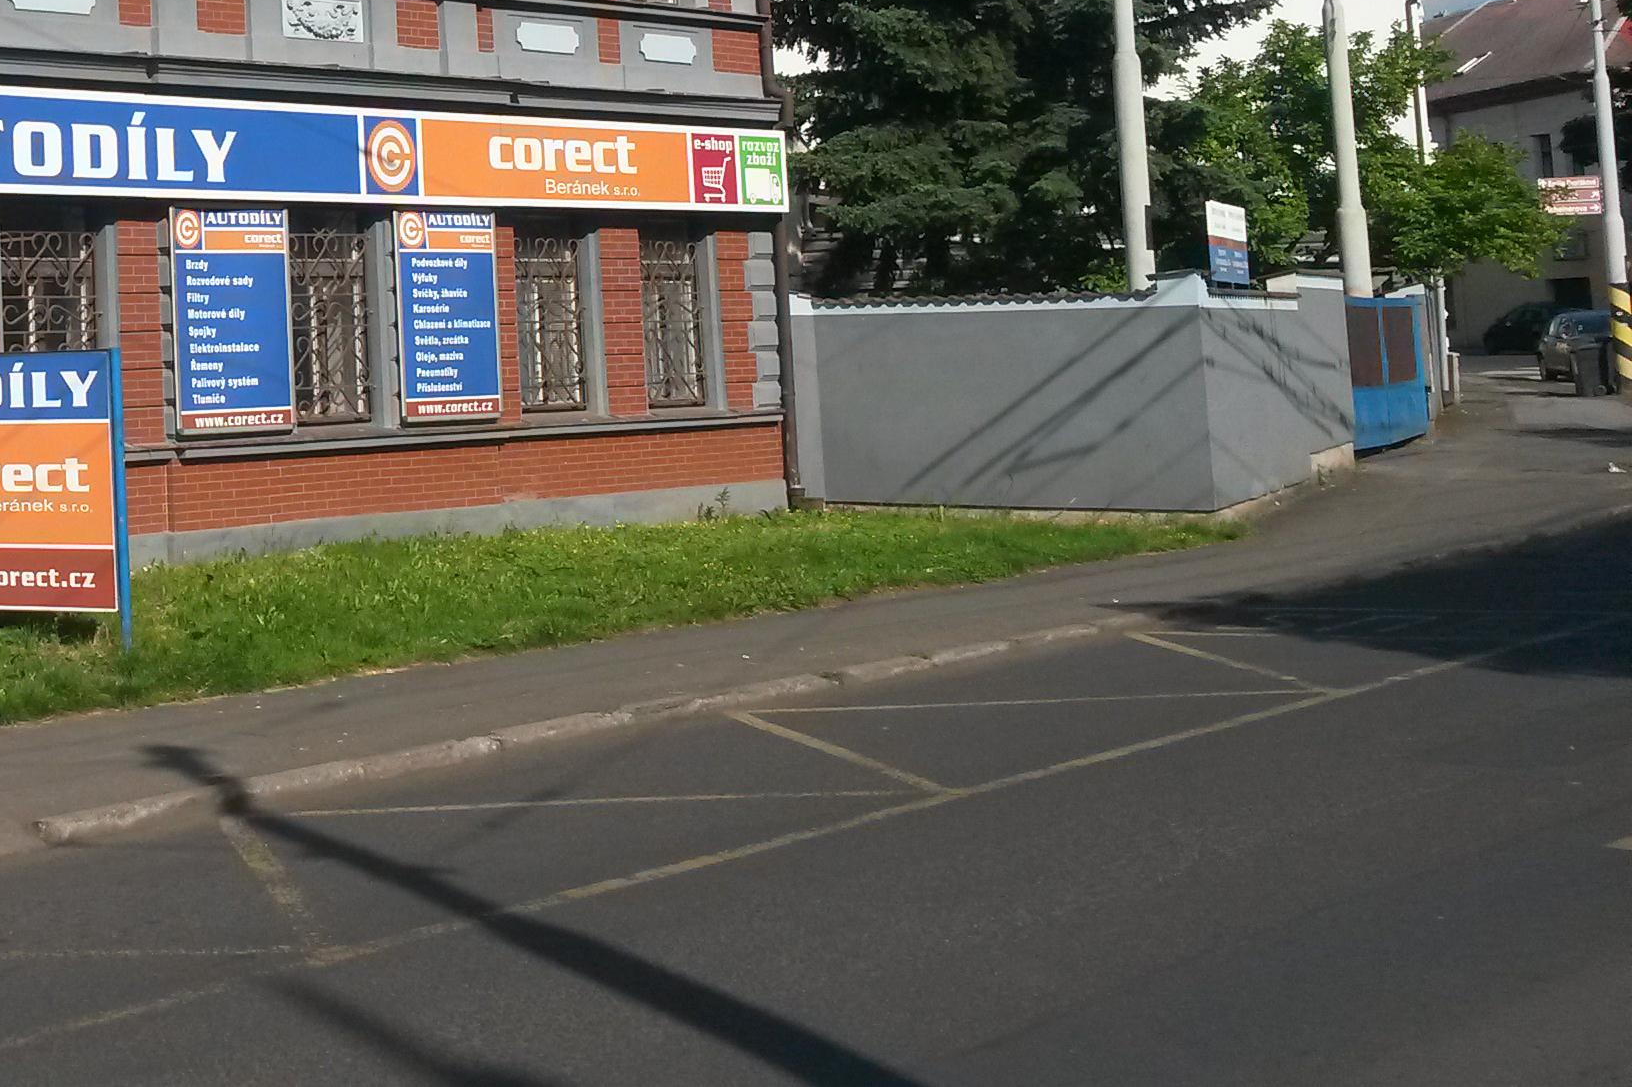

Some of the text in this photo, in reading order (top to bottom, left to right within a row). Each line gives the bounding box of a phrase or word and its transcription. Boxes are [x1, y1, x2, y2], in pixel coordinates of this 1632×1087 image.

[693, 137, 734, 155] e-shop
[741, 140, 780, 154] rozvoz
[488, 135, 638, 175] corect
[746, 152, 776, 167] zboží
[545, 178, 641, 197] Beránek s.r.o.
[206, 210, 282, 225] AUTODÍLY
[428, 213, 490, 226] AUTODÍLY
[244, 234, 282, 243] corect
[460, 234, 490, 244] corect
[185, 259, 208, 271] Brzdy
[411, 257, 467, 269] Podvozkové díly
[186, 275, 253, 287] Rozvodové sady
[412, 273, 437, 284] Výfuky
[187, 292, 209, 304] Filtry
[188, 308, 245, 320] Motorové díly
[413, 304, 449, 314] Karosérie
[454, 319, 491, 328] klimatizace
[188, 326, 216, 338] Spojky
[443, 336, 469, 345] zrcátka
[190, 342, 260, 354] Elektroinstalace
[415, 351, 464, 363] Oleje, maziva
[190, 359, 223, 372] Řemeny
[416, 367, 458, 378] Pneumatiky
[191, 376, 259, 389] Palivový systém
[192, 394, 226, 404] Tlumiče
[418, 401, 493, 415] www.corect.cz
[195, 413, 284, 428] www.corect.cz
[59, 503, 93, 513] s.r.o.
